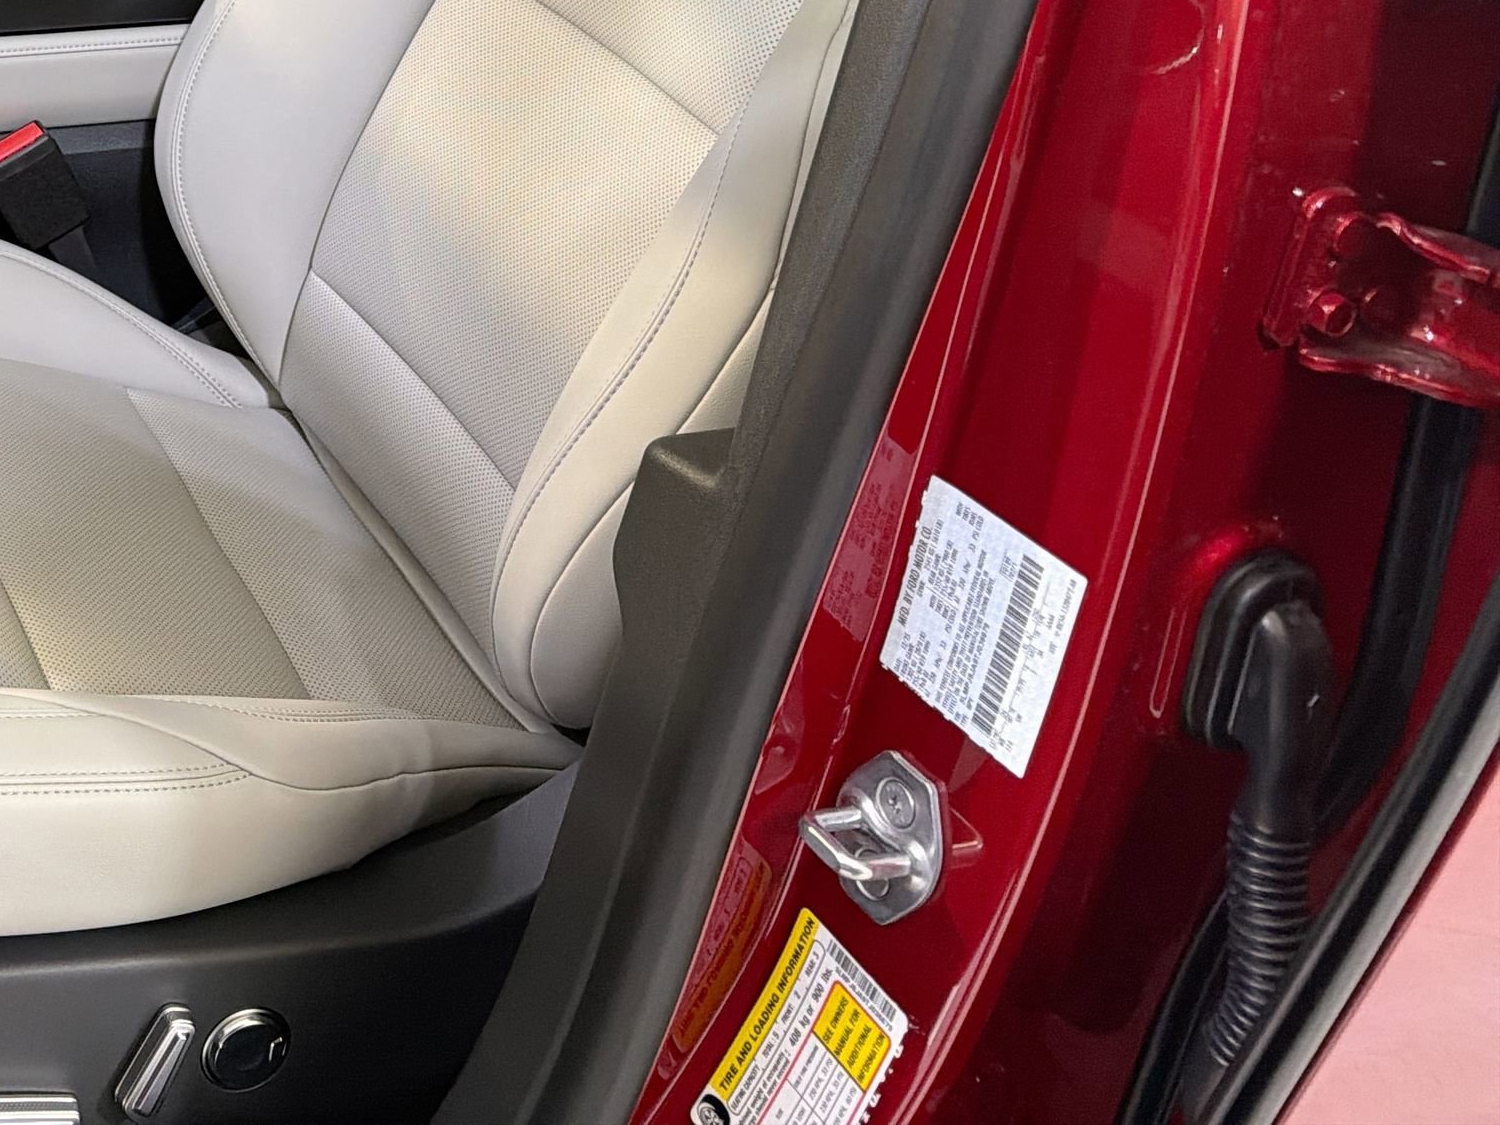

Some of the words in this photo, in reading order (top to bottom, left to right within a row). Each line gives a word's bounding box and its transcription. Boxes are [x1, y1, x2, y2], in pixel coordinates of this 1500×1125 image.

[913, 539, 928, 571] MOTOR
[906, 569, 920, 593] FORD
[903, 590, 913, 605] BY
[897, 606, 909, 627] MFD.
[719, 1063, 739, 1091] TIRE
[736, 1041, 752, 1066] AND
[749, 993, 780, 1042] LOADING
[776, 917, 815, 994] INFORMATION
[794, 990, 801, 999] 2
[789, 1027, 801, 1047] 408
[798, 1015, 810, 1029] kg
[806, 1004, 814, 1016] or
[812, 983, 824, 1002] 900
[849, 1009, 860, 1027] FOR
[822, 1027, 834, 1044] SEE
[847, 1024, 872, 1069] ADDITIONAL
[856, 1032, 885, 1084] INFORMATION
